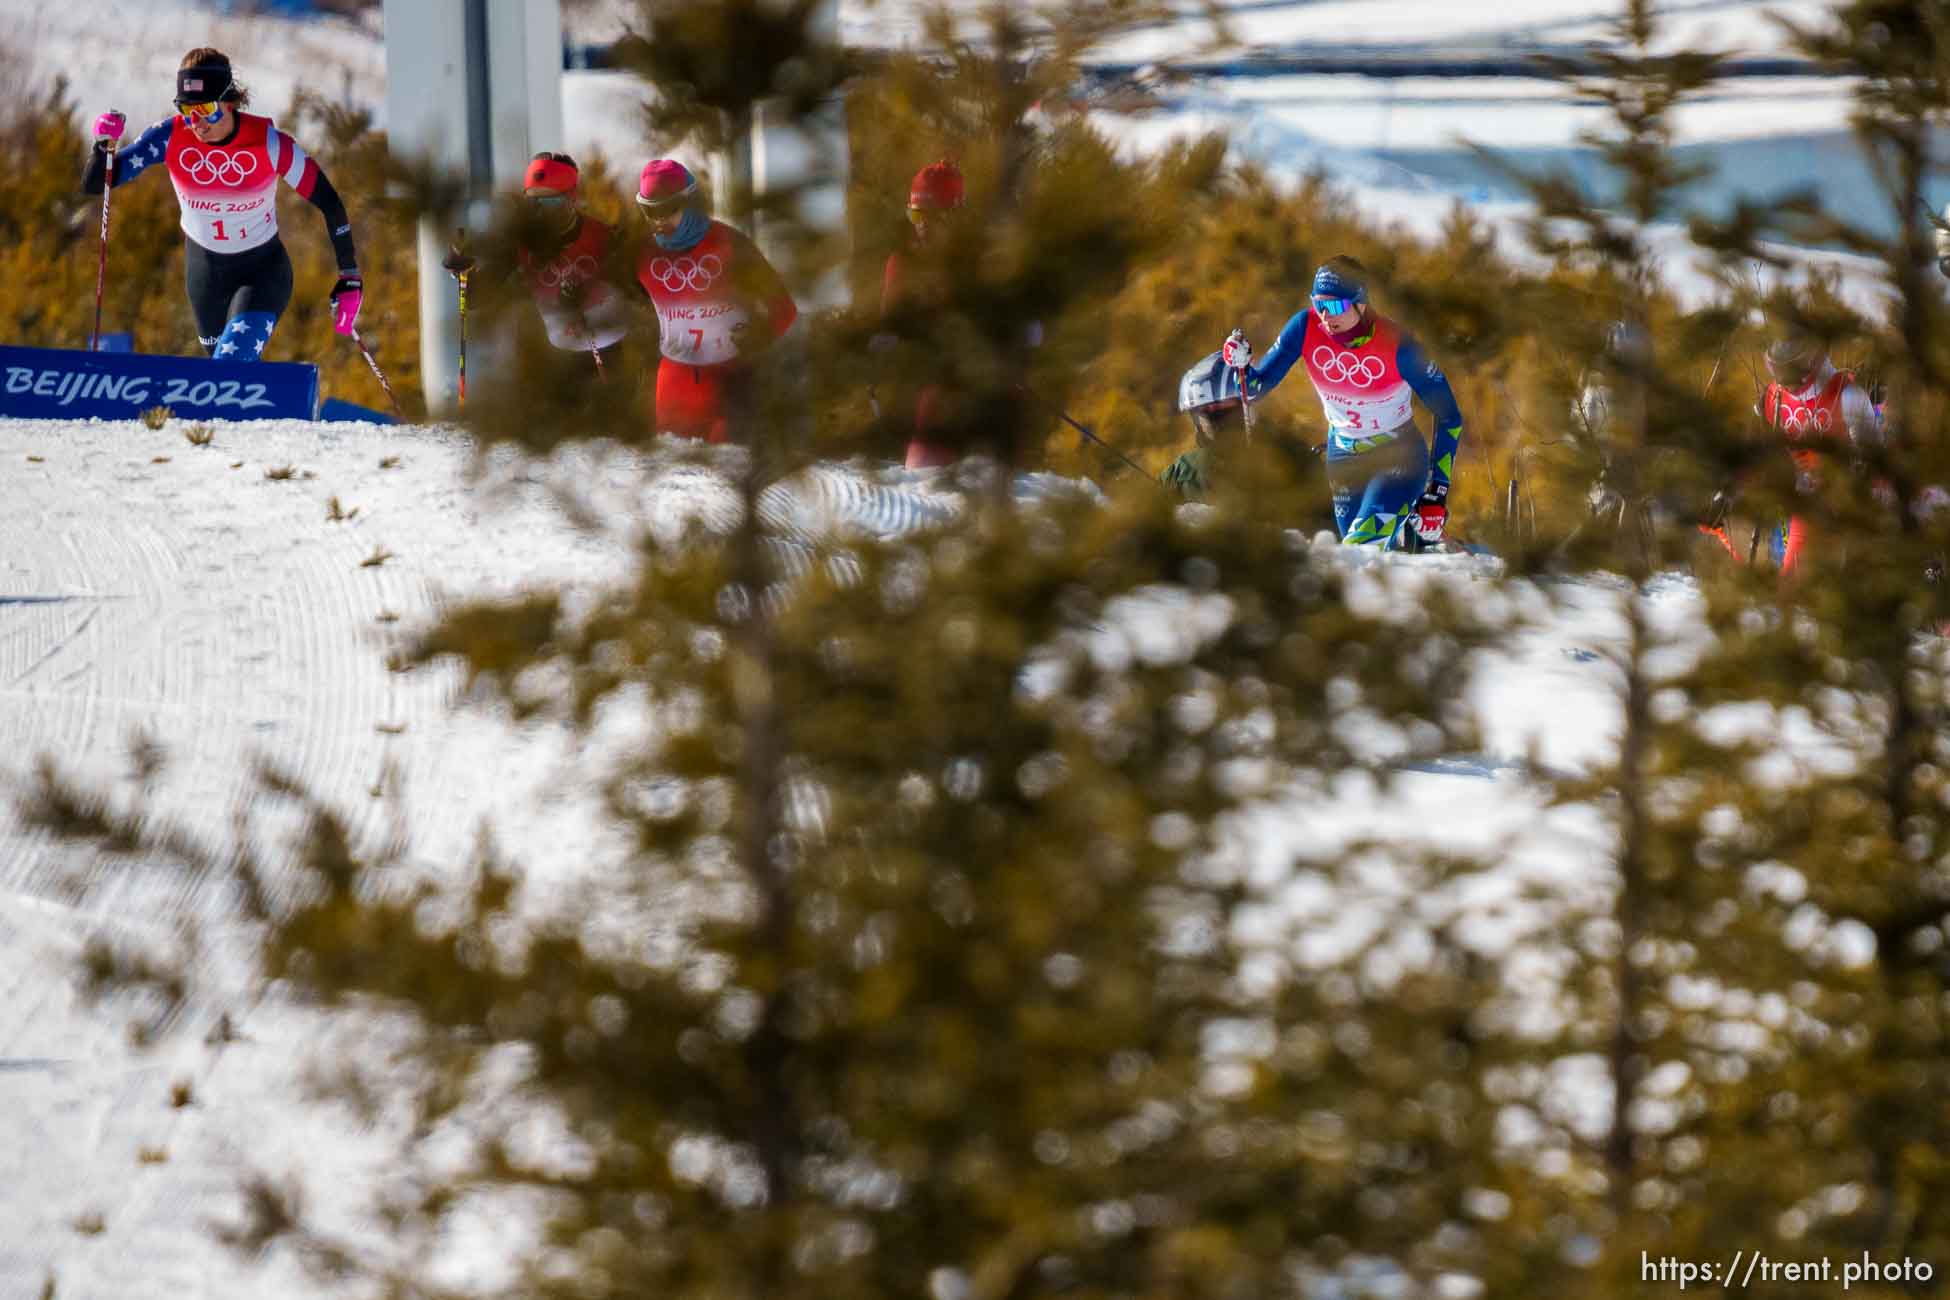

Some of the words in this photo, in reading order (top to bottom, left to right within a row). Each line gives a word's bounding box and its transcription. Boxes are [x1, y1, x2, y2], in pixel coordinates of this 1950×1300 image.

[211, 219, 230, 240] 1
[688, 328, 704, 353] 7
[5, 366, 150, 406] BEIJING
[161, 378, 276, 409] 2022
[1345, 410, 1362, 429] 3
